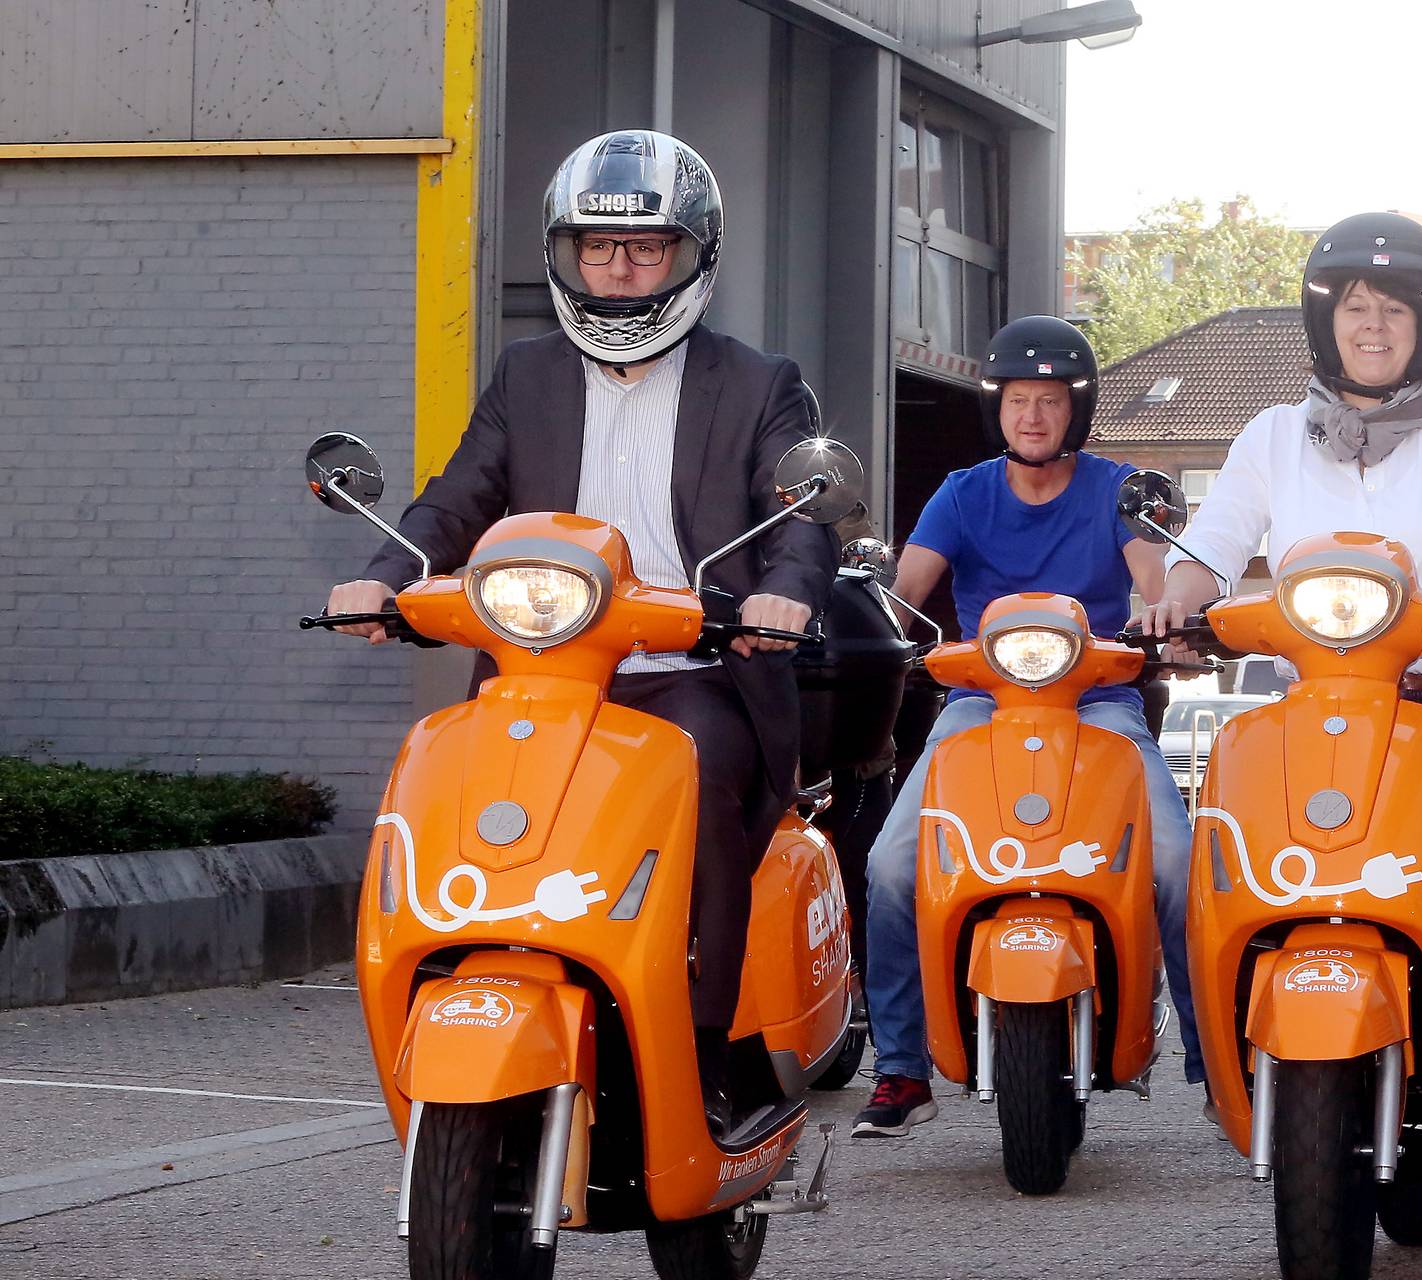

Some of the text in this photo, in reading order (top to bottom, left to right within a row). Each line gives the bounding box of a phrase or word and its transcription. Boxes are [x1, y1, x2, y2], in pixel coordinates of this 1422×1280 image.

[588, 193, 645, 213] SHOEI
[1007, 916, 1054, 924] 18012
[1009, 944, 1051, 952] SHARING
[1293, 949, 1353, 960] 18003
[453, 977, 520, 987] 18004
[1296, 984, 1347, 993] SHARING
[441, 1017, 497, 1028] SHARING
[718, 1137, 781, 1181] Wir tanken Strom!
